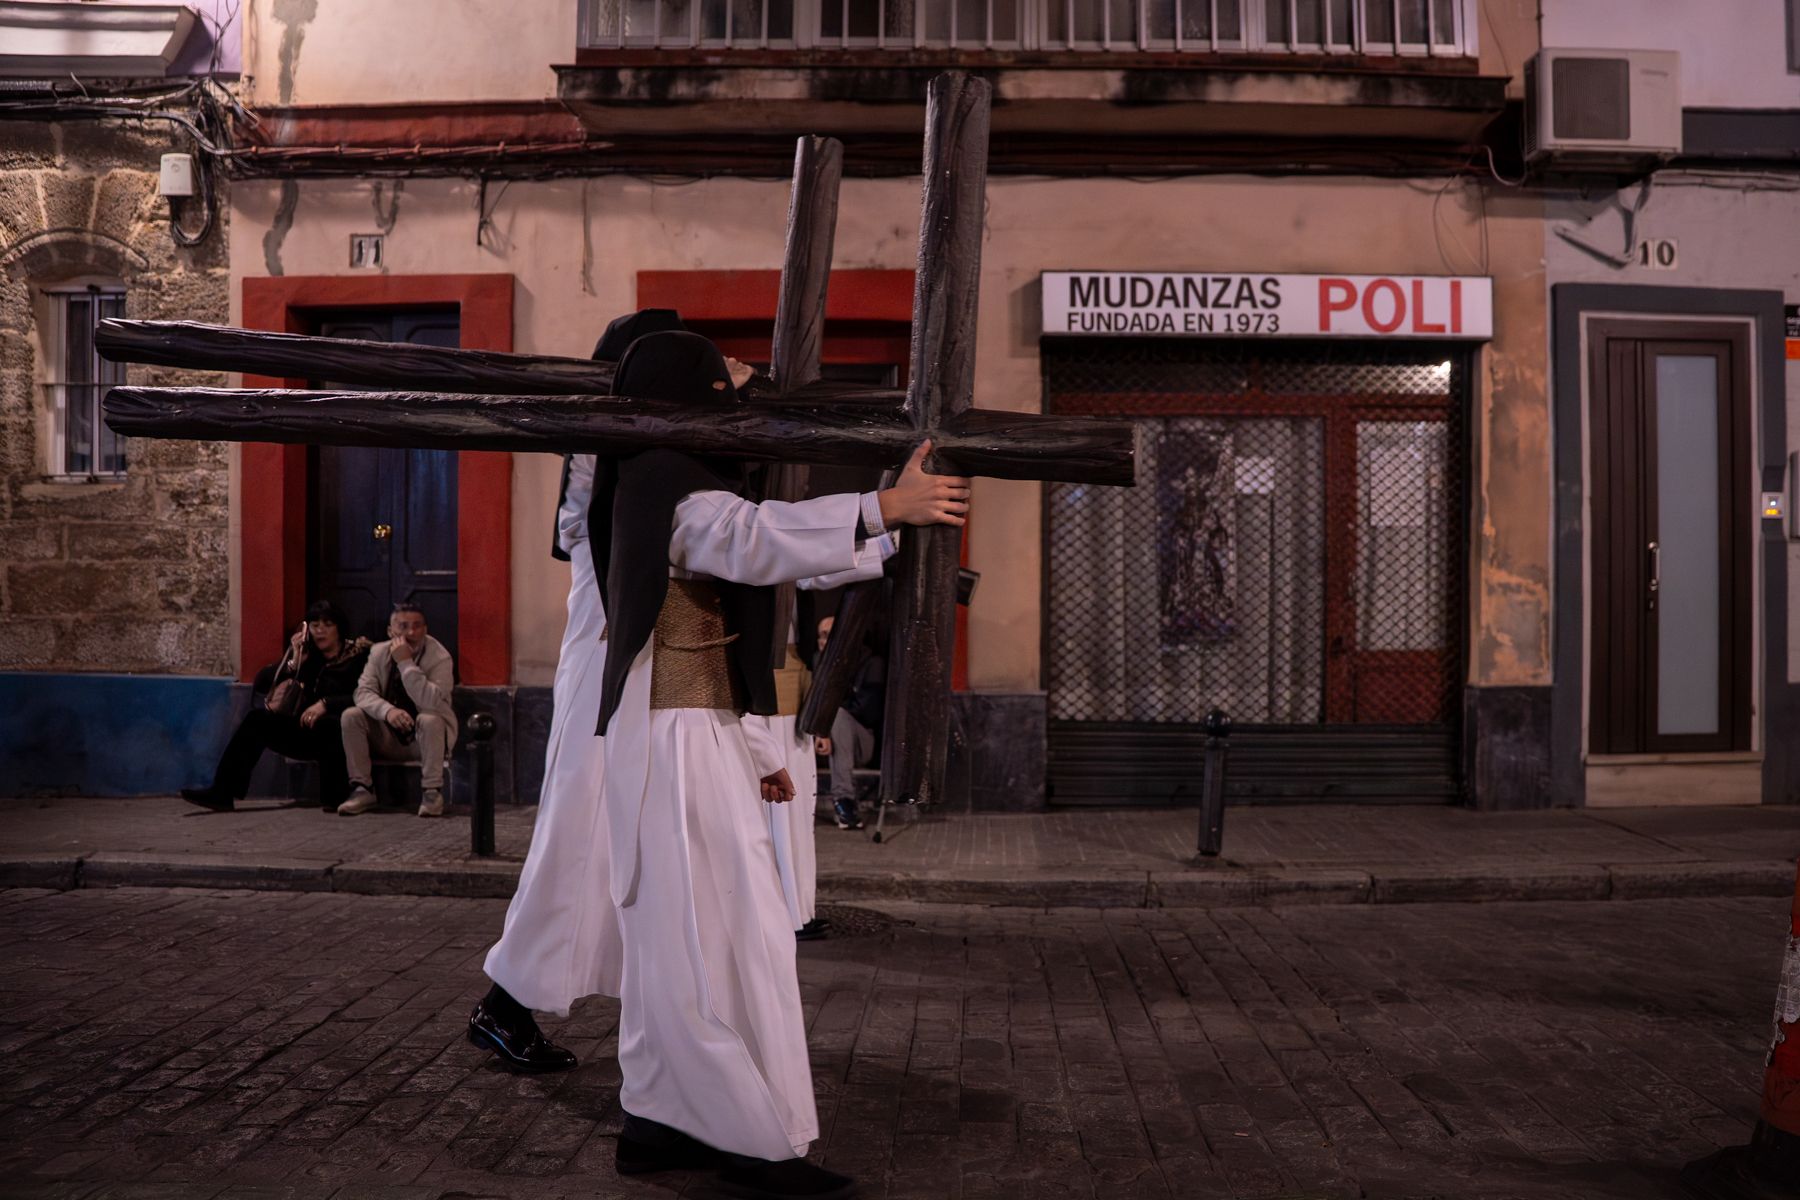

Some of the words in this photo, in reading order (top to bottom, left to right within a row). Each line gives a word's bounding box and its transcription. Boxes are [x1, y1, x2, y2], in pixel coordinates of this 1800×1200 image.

[1639, 240, 1675, 267] 10
[1069, 276, 1281, 309] MUDANZAS
[1318, 278, 1462, 334] POLI
[1067, 312, 1175, 332] FUNDADA
[1184, 313, 1213, 332] EN
[1224, 313, 1280, 333] 1973
